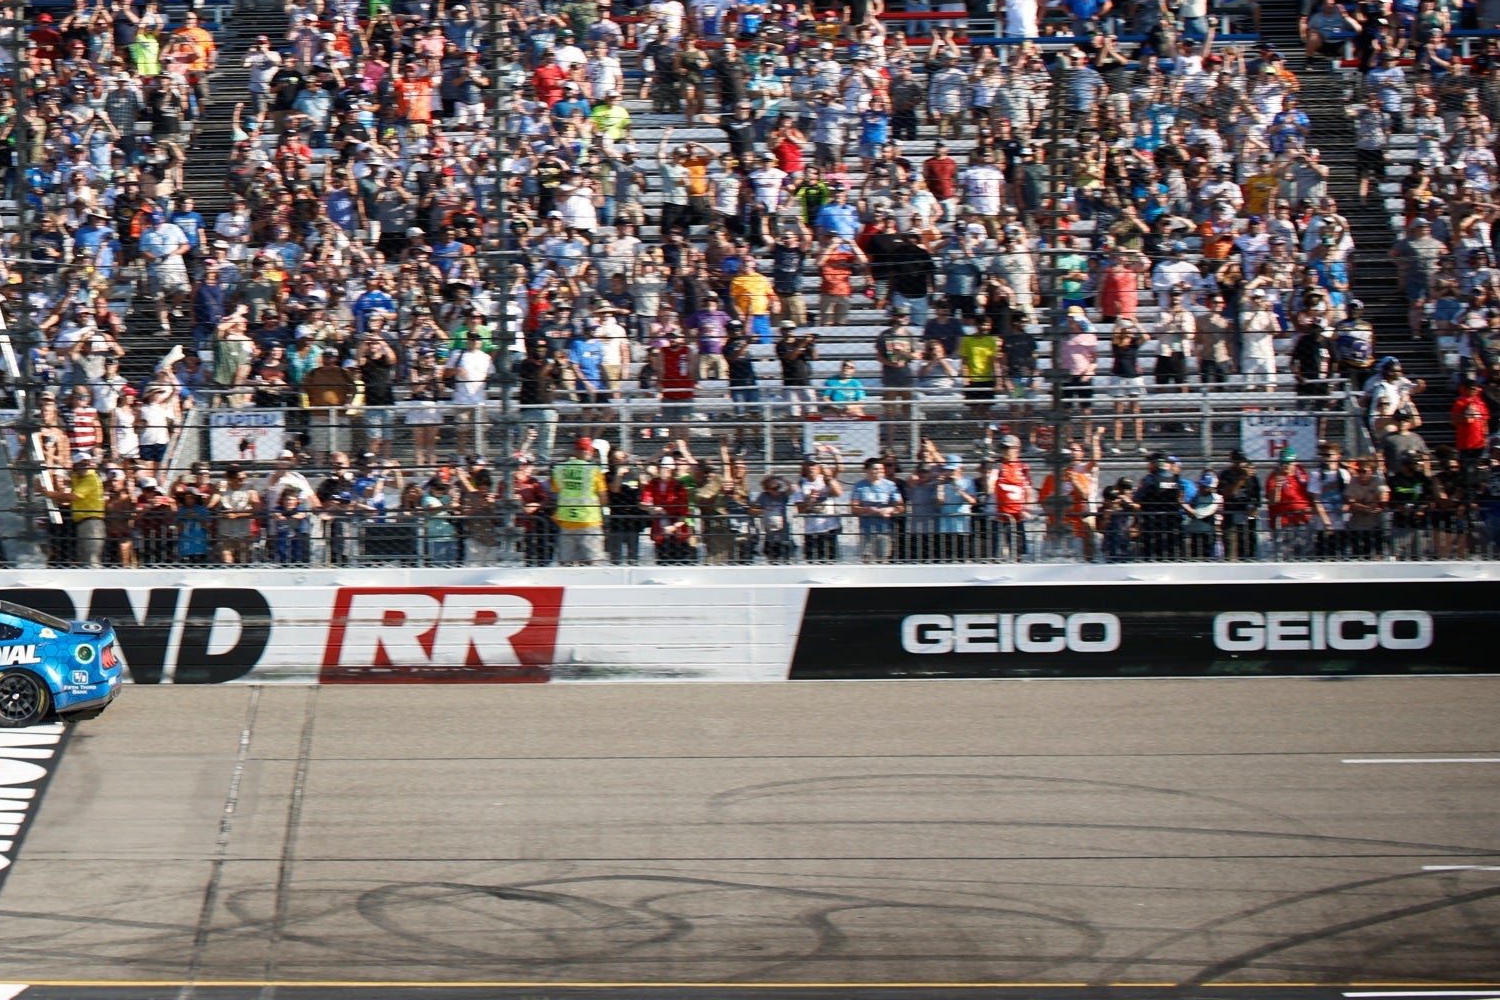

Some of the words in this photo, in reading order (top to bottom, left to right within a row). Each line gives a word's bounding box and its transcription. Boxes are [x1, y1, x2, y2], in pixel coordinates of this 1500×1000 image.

[338, 593, 534, 667] RR
[900, 612, 1121, 654] GEICO
[1213, 610, 1434, 652] GEICO
